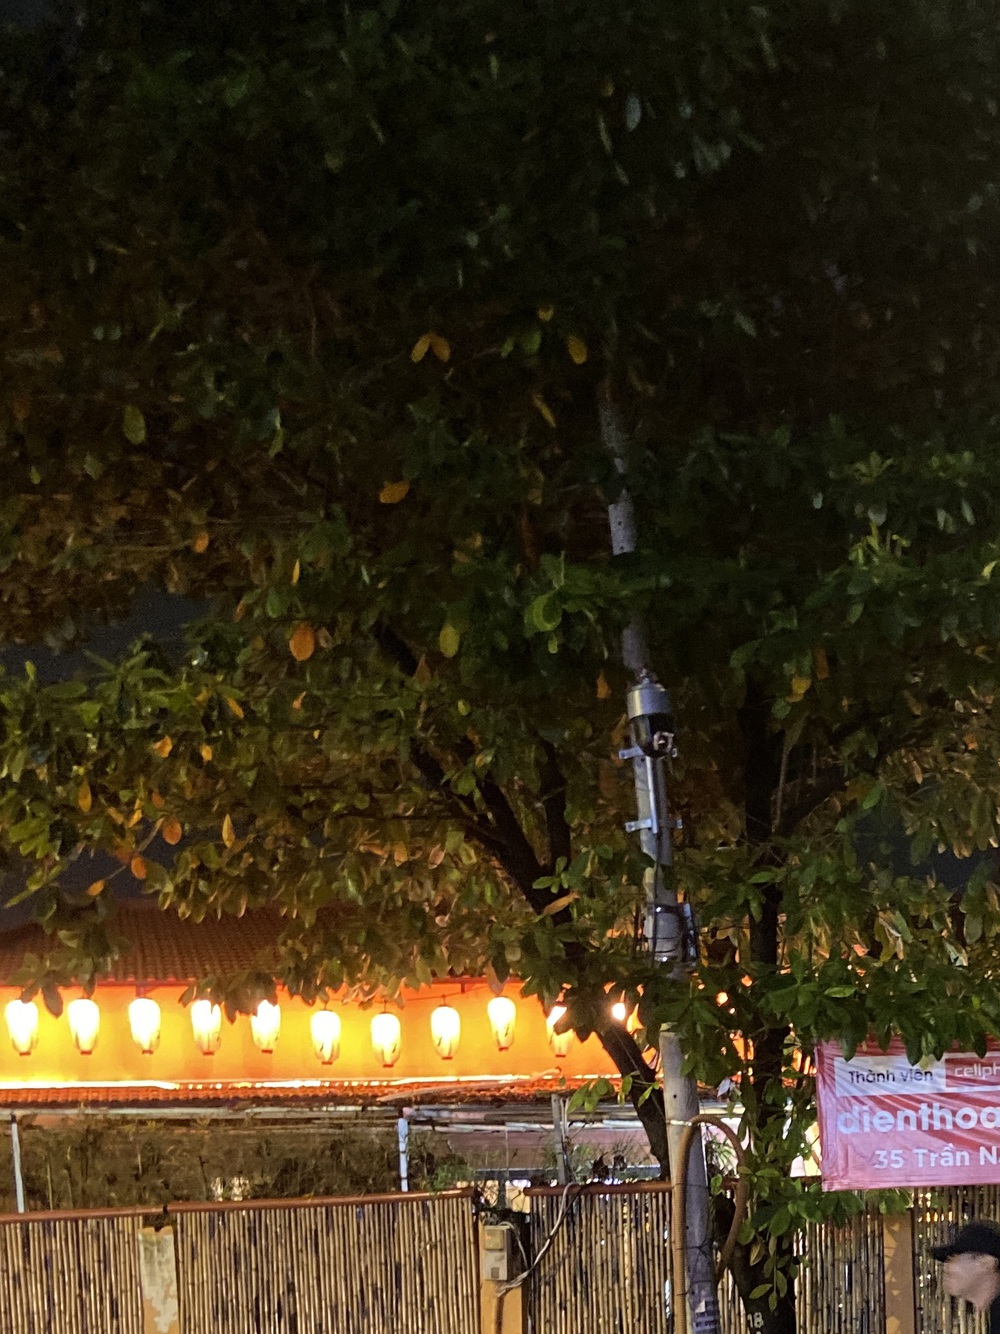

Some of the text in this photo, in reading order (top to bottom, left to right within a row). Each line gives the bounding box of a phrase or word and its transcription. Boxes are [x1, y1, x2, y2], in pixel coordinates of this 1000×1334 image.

[849, 1068, 934, 1084] Thành viên
[874, 1150, 904, 1169] 35
[914, 1143, 970, 1168] Trần
